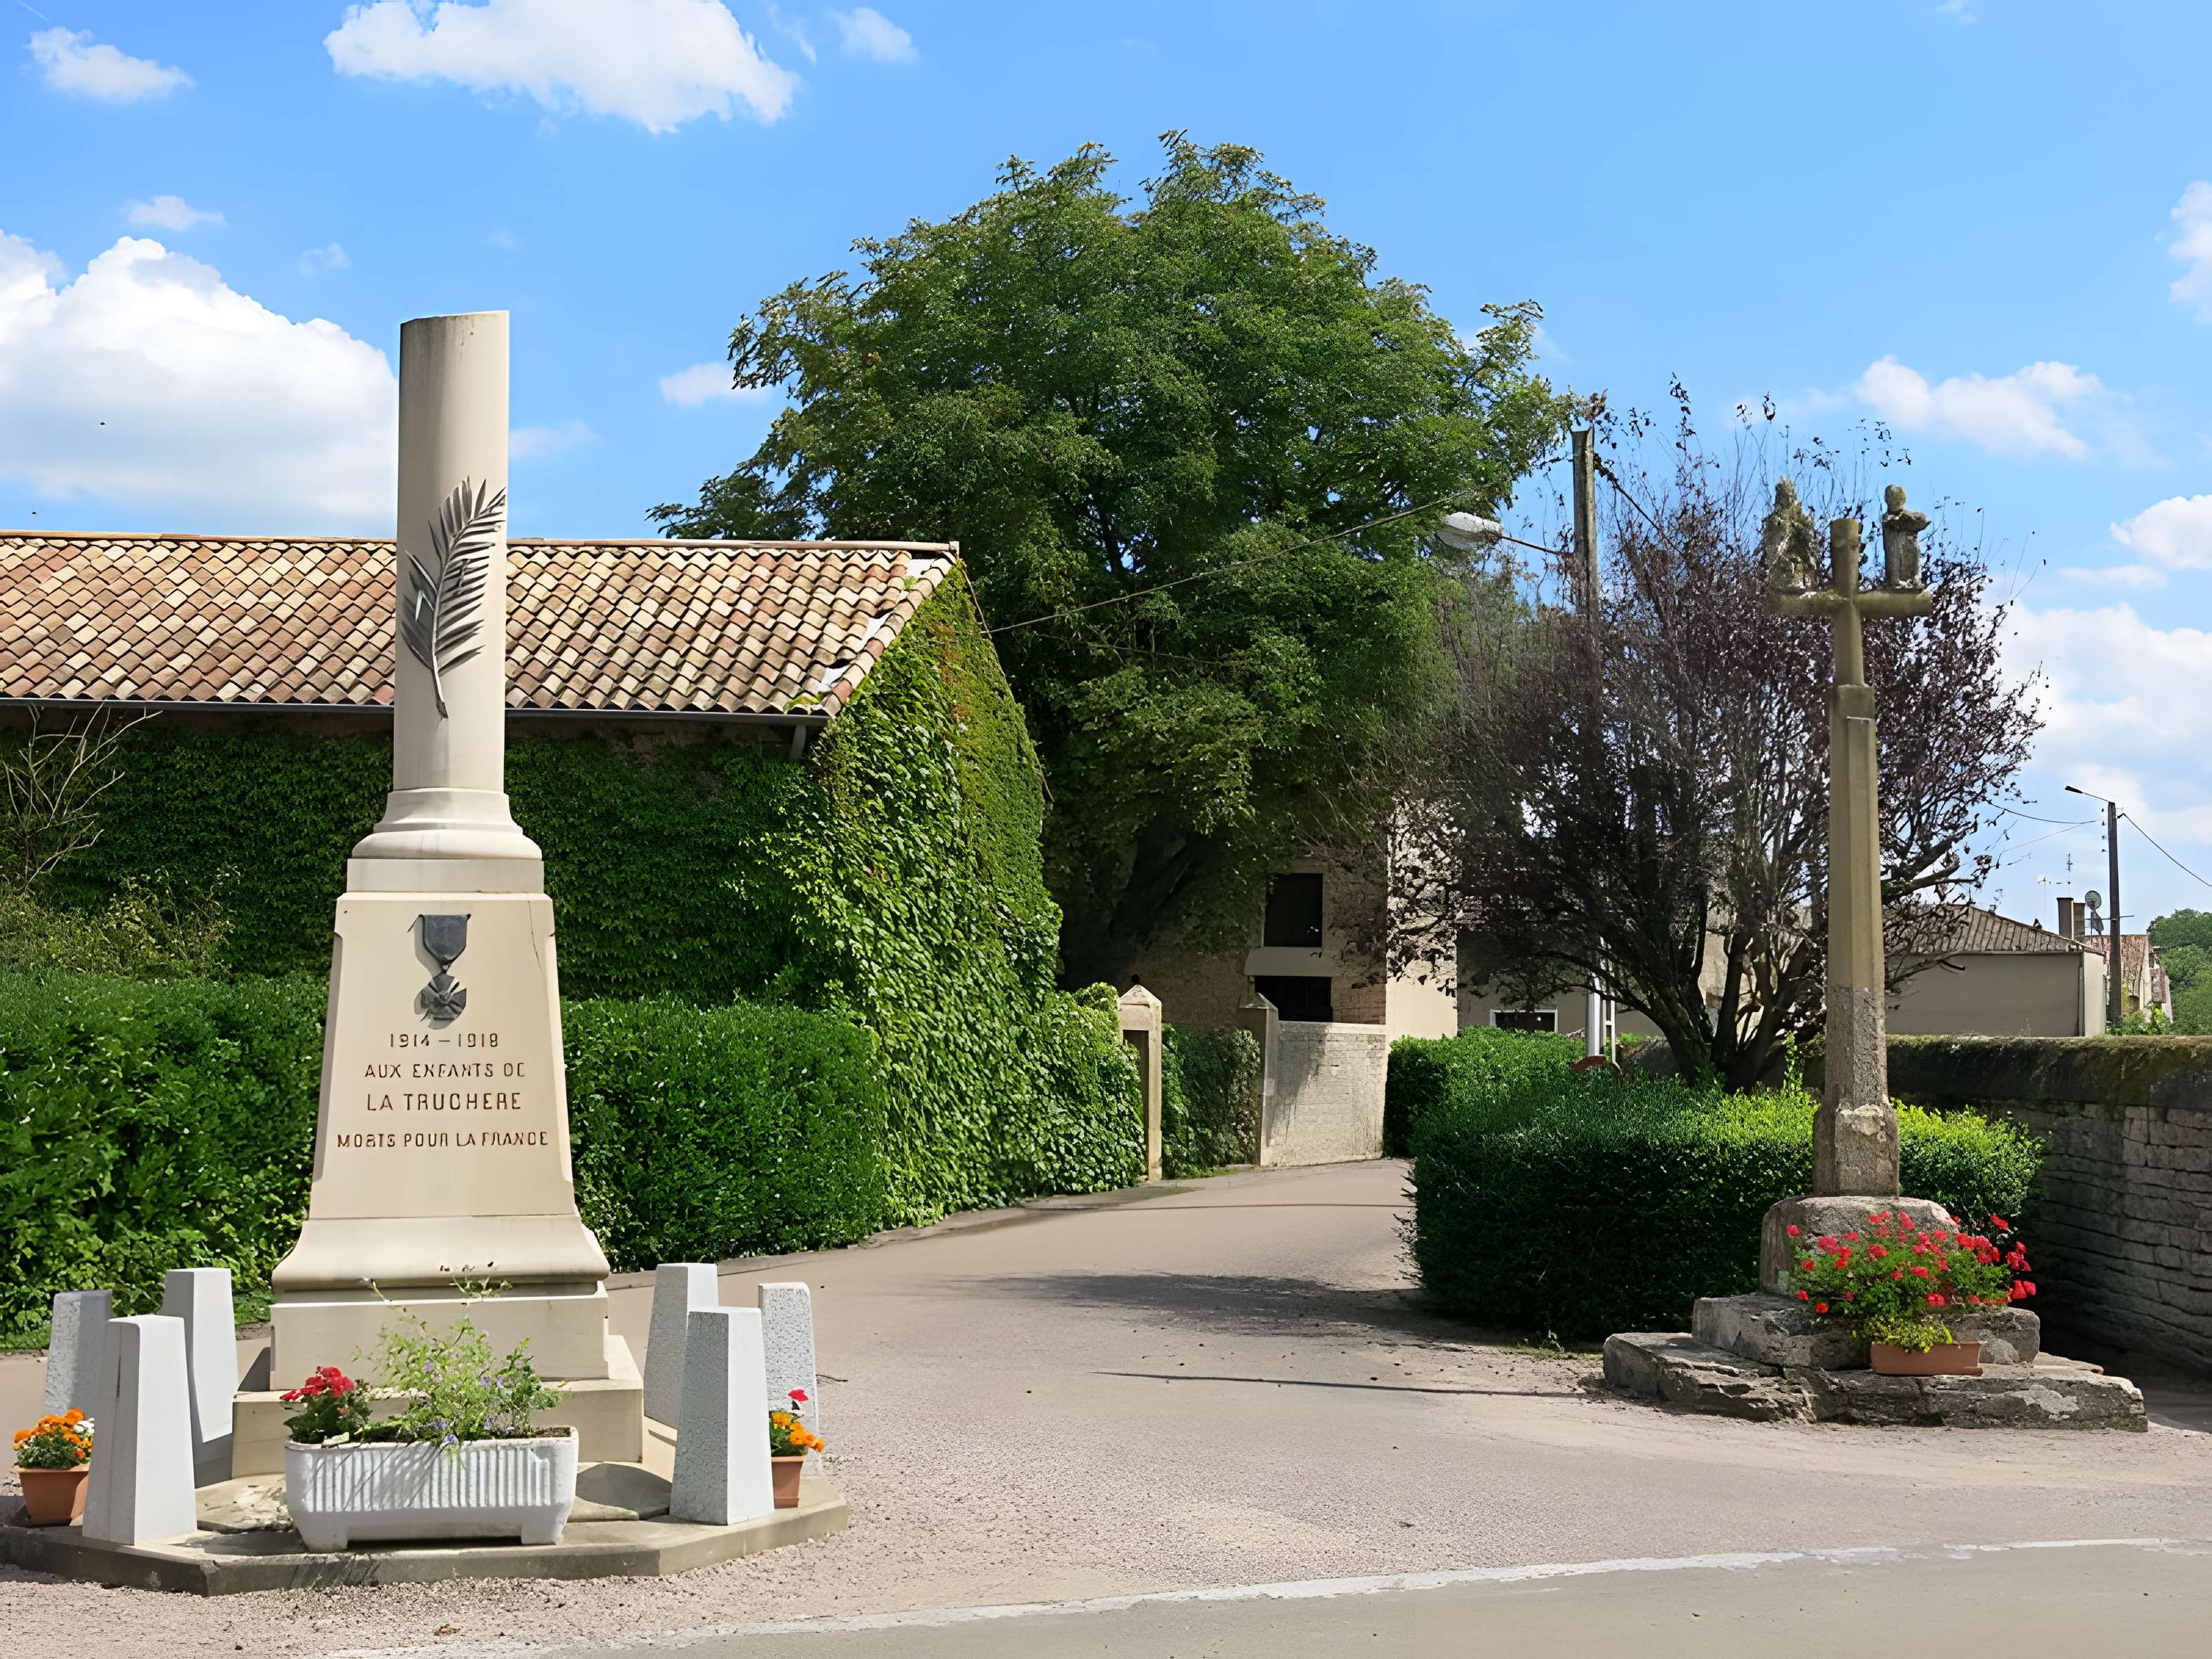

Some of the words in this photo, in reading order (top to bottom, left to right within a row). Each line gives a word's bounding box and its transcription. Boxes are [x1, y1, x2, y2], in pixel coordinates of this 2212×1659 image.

[364, 1063, 402, 1078] AUX
[366, 1092, 394, 1112] LA
[403, 1132, 449, 1147] POUR
[456, 1132, 476, 1147] LA
